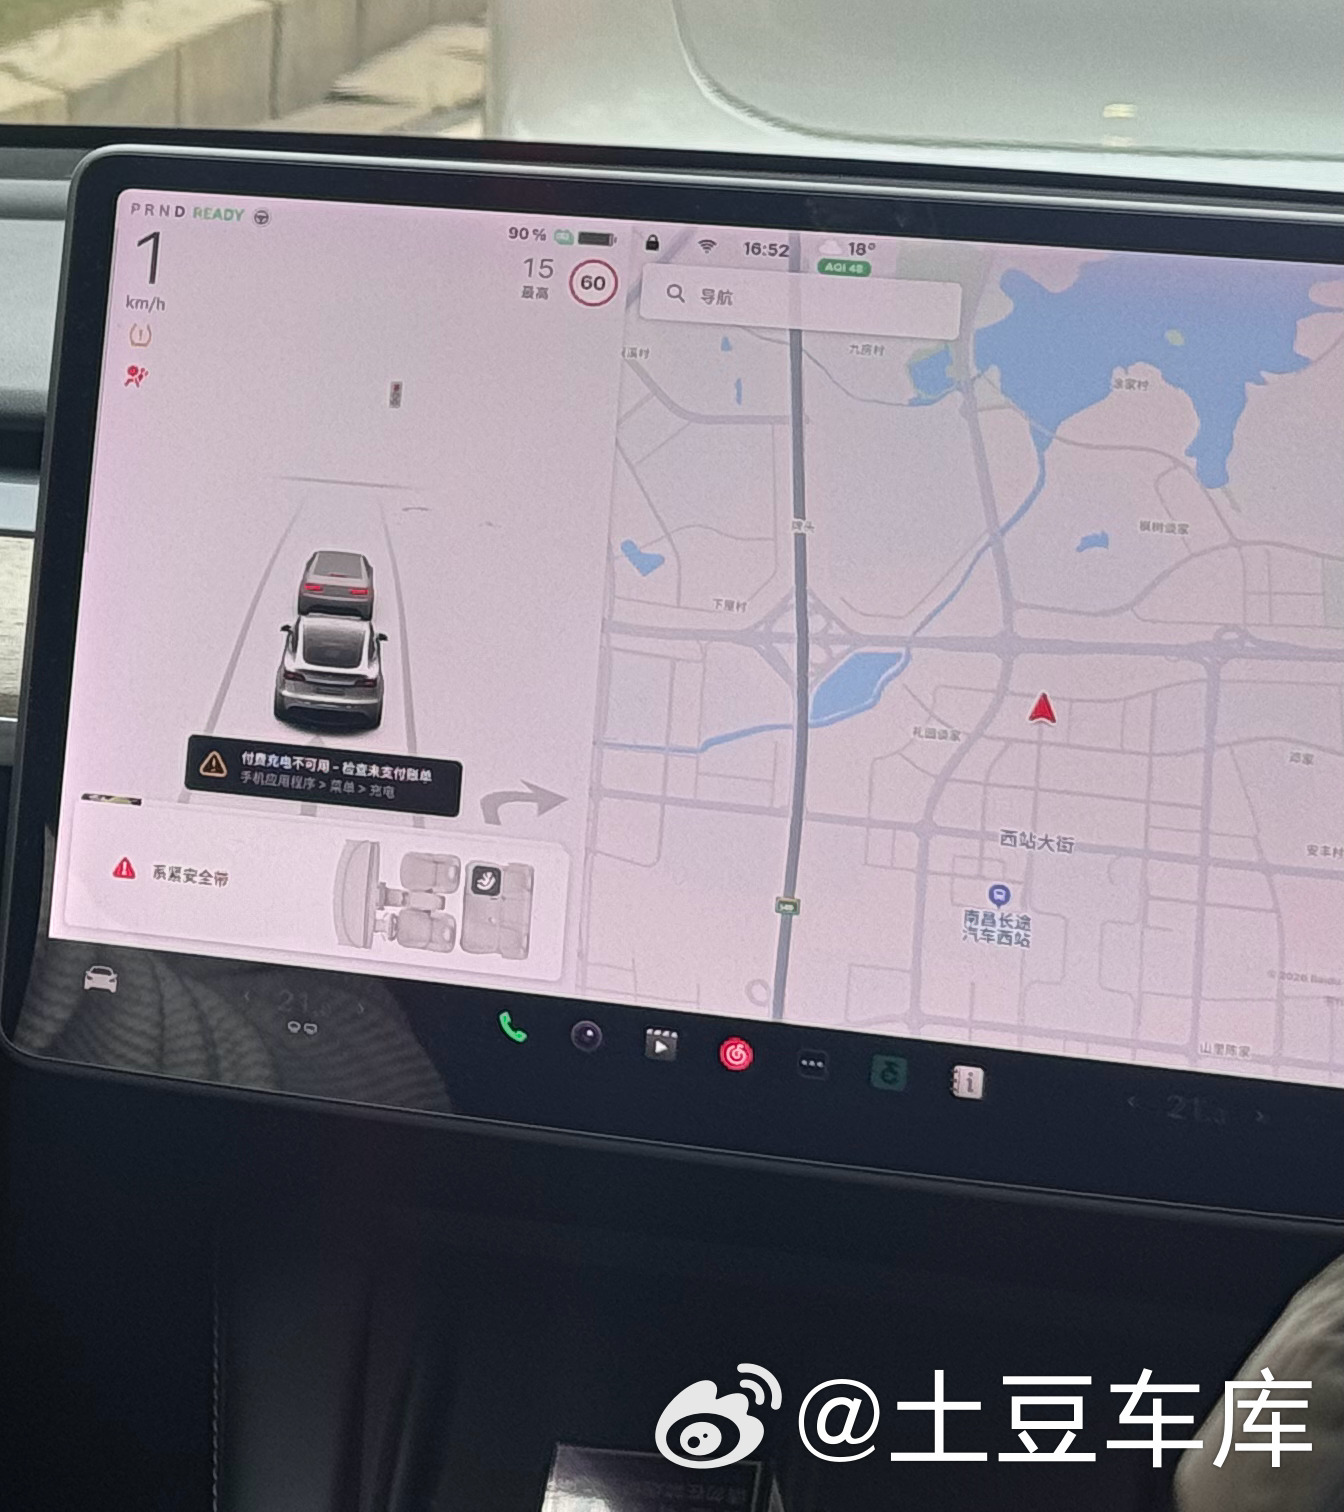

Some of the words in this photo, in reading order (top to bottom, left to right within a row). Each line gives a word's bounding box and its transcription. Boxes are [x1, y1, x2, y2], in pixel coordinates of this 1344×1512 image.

[192, 206, 245, 223] READY
[136, 231, 162, 285] 1
[744, 242, 790, 257] 16:52
[522, 257, 554, 279] 15
[521, 285, 549, 300] 最高
[580, 275, 606, 291] 60
[125, 294, 166, 312] km/h
[700, 288, 733, 307] 导航
[1000, 829, 1075, 853] 西站大街
[153, 864, 229, 888] 系紧安全带
[963, 909, 1031, 932] 南昌长途
[962, 927, 1031, 948] 汽车西站
